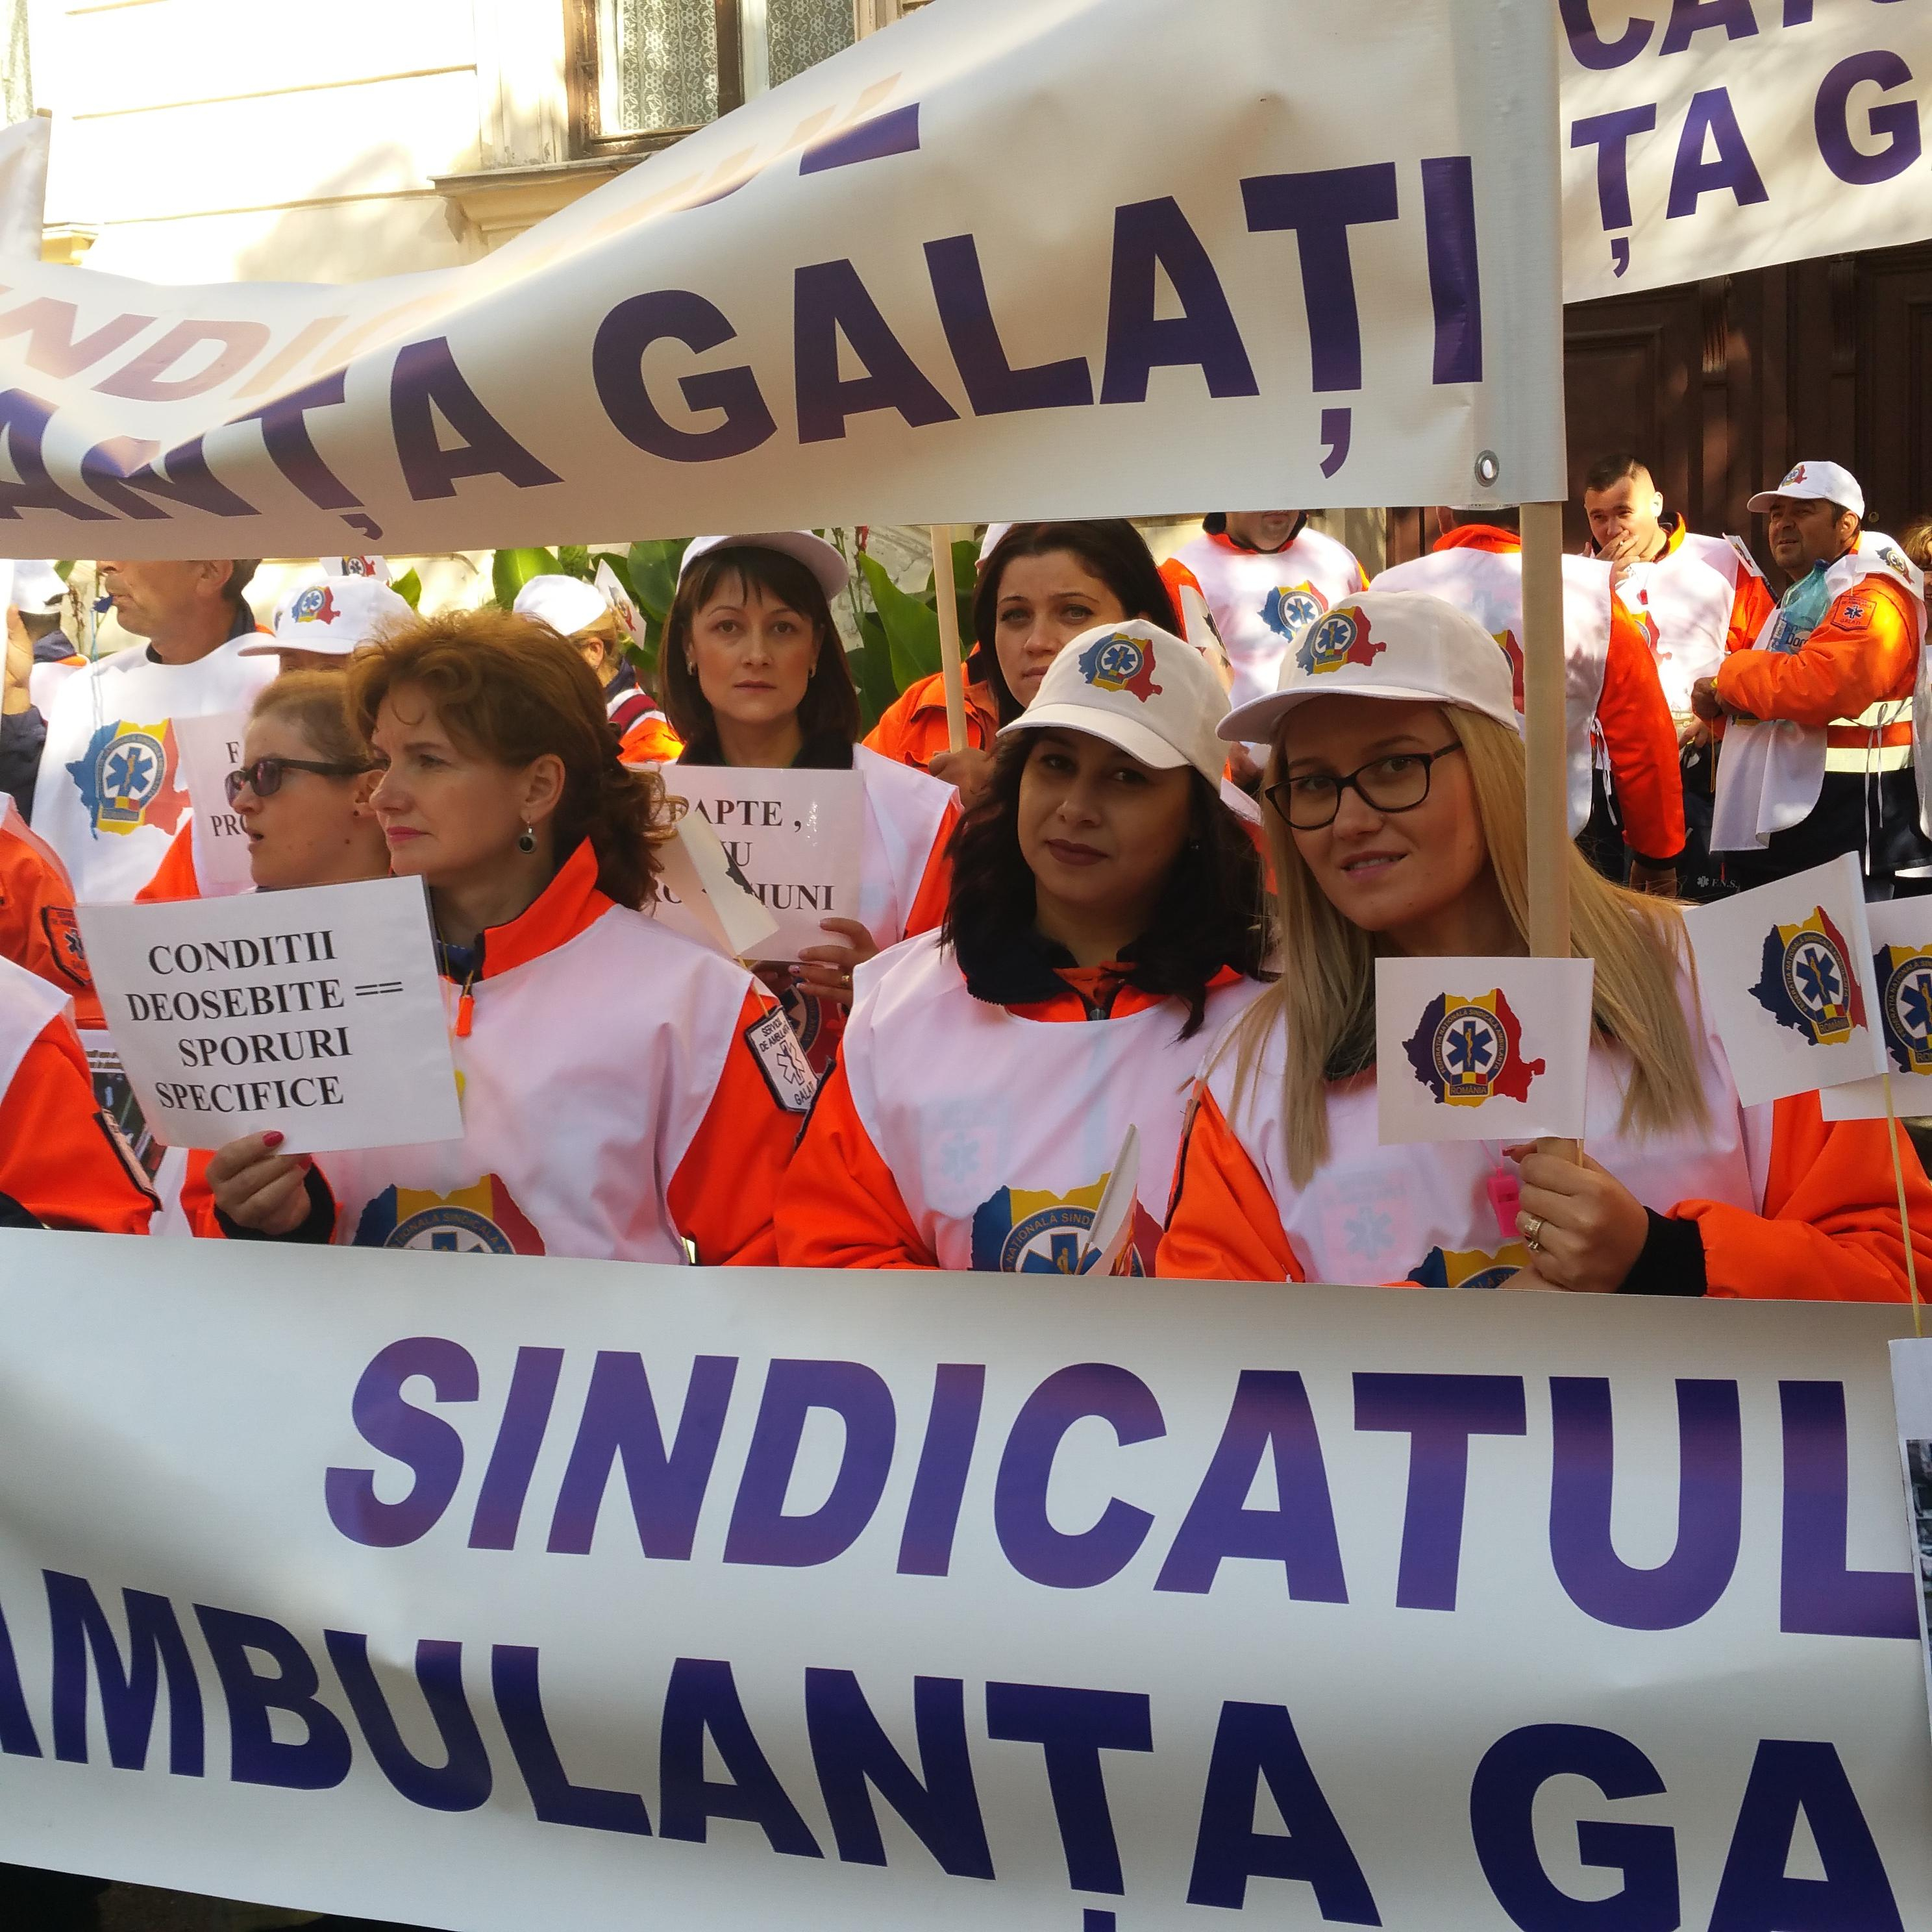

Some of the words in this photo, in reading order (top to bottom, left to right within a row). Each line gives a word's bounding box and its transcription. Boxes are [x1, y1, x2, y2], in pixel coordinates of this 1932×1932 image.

[592, 156, 1483, 479] GALAȚI
[148, 930, 338, 975] CONDITII
[125, 978, 345, 1022] DEOSEBITE
[178, 1026, 353, 1068] SPORURI
[155, 1076, 345, 1113] SPECIFICE
[325, 1336, 1920, 1640] SINDICATUL
